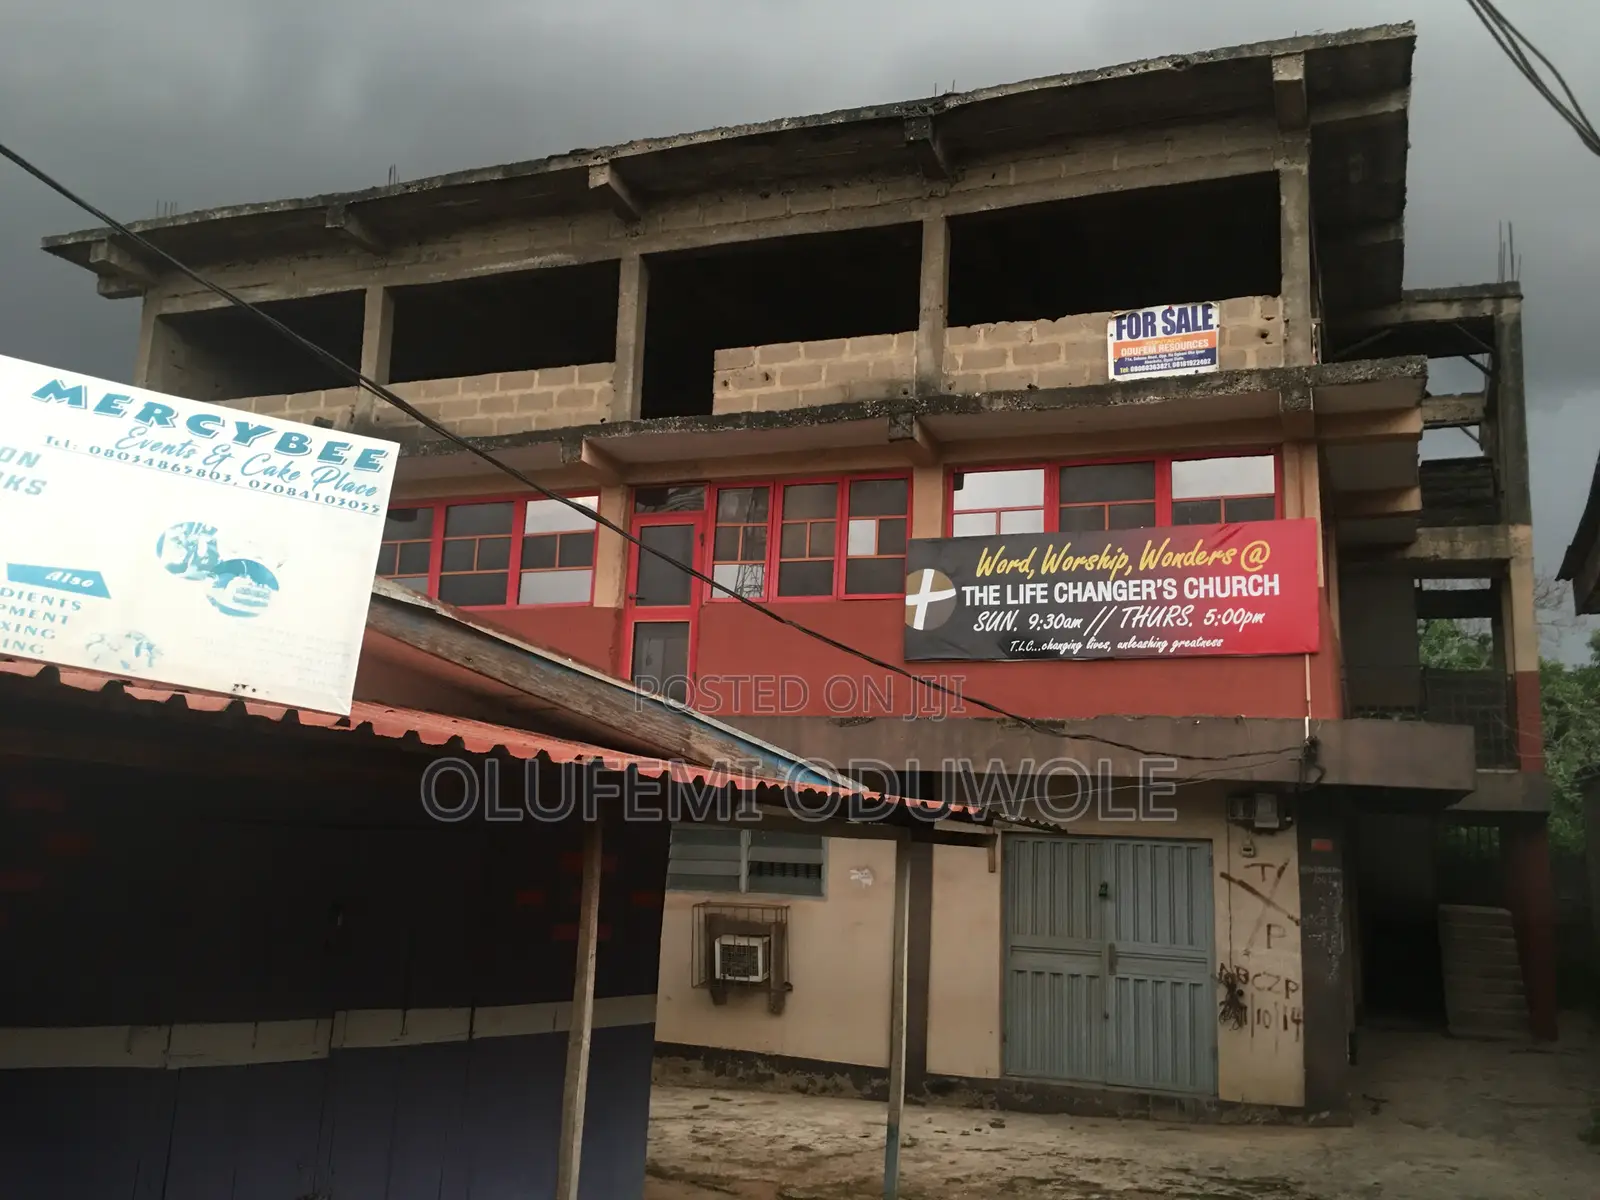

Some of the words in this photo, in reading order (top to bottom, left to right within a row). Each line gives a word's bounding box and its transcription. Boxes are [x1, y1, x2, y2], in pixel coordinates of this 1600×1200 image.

[1115, 311, 1157, 341] FOR
[1161, 303, 1214, 336] SALE
[1158, 338, 1209, 354] RESOURCES
[31, 379, 388, 473] MERCYBEE
[115, 426, 201, 459] Events
[241, 453, 301, 483] Cake
[311, 465, 378, 497] Place
[976, 545, 1038, 580] Word,
[1041, 542, 1133, 581] Worship,
[1139, 538, 1238, 571] Wonders
[1240, 540, 1271, 572] @
[45, 570, 94, 588] Also
[961, 584, 1000, 606] THE
[1006, 583, 1049, 605] LIFE
[1054, 578, 1178, 604] CHANGER'S
[1183, 573, 1280, 599] CHURCH
[973, 609, 1019, 632] SUN.
[1028, 613, 1083, 631] 9:30am
[1120, 604, 1195, 629] THURS.
[1203, 607, 1266, 632] 5:00pm
[1086, 636, 1112, 653] lives,
[1117, 635, 1168, 653] unleashing
[1172, 636, 1224, 653] greatness
